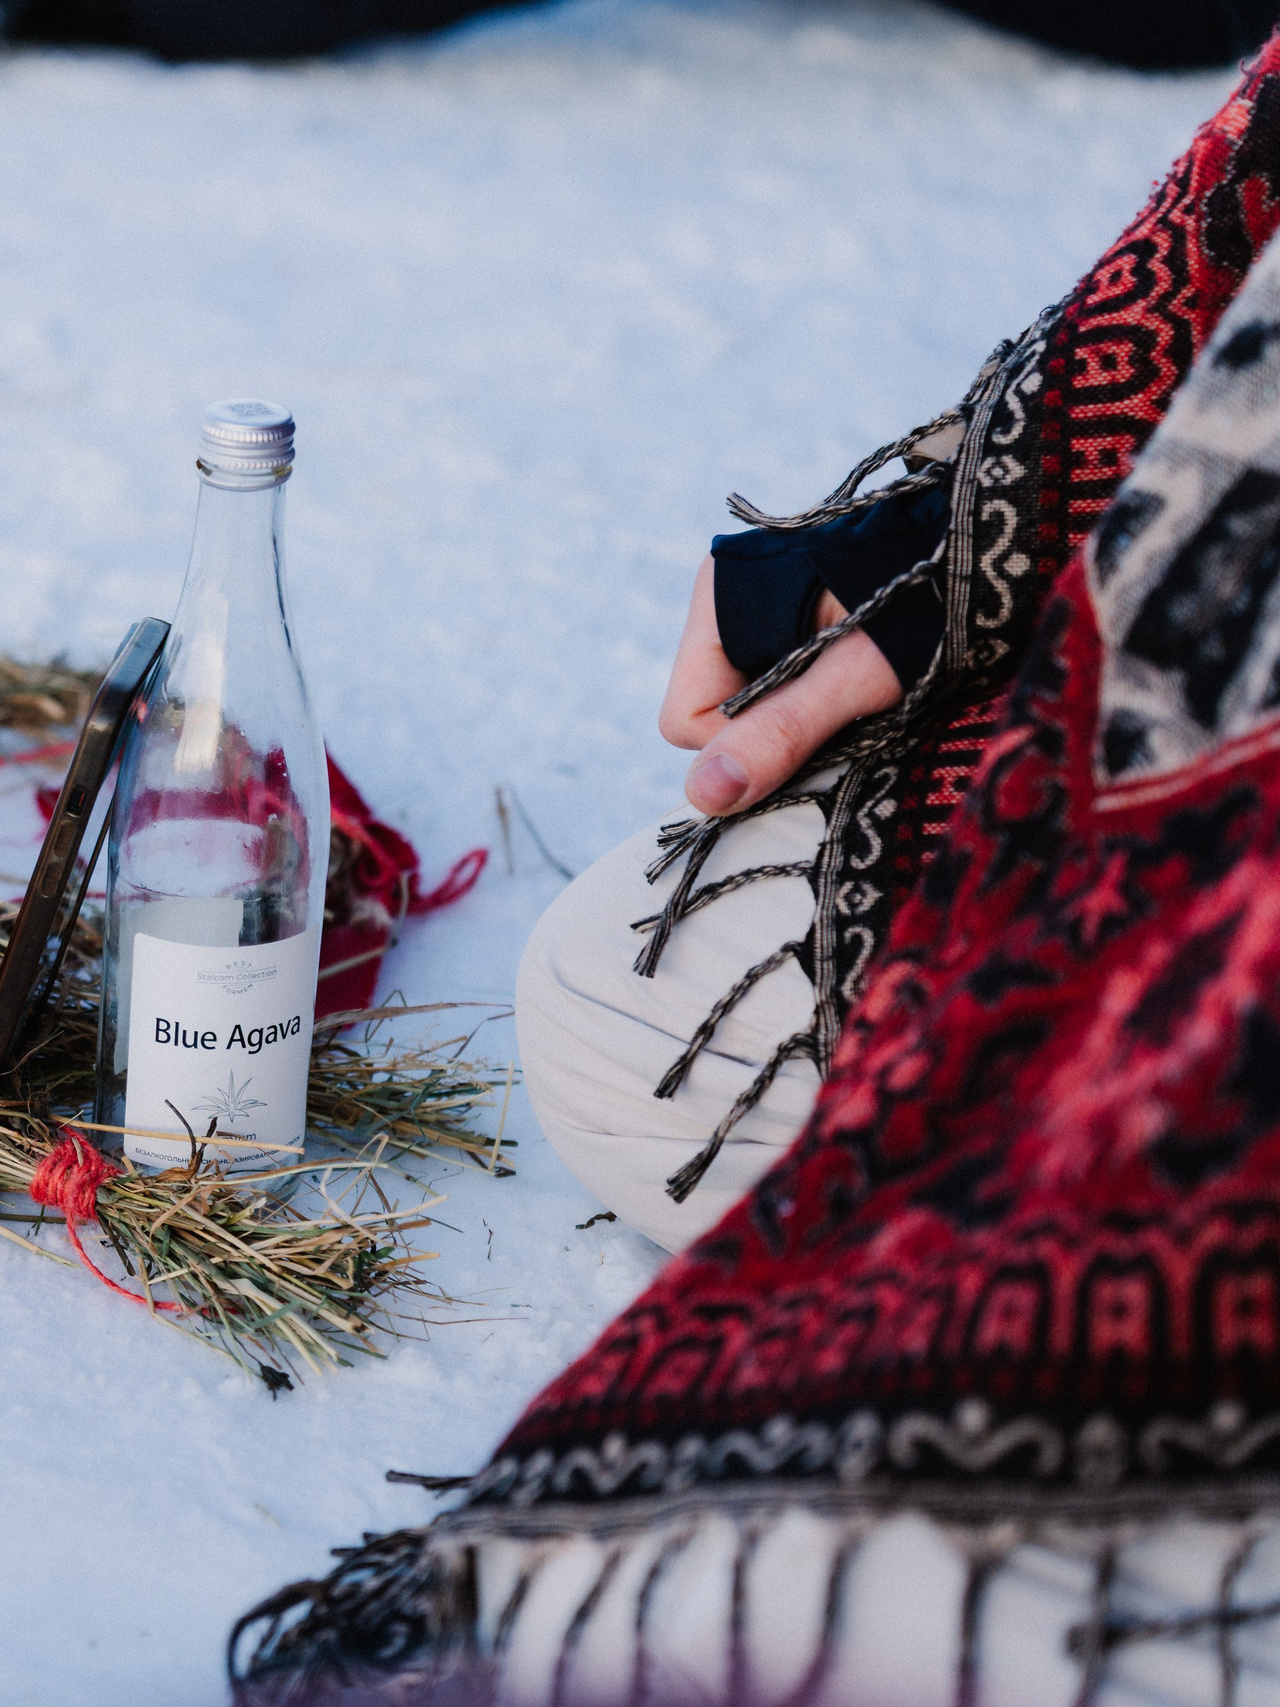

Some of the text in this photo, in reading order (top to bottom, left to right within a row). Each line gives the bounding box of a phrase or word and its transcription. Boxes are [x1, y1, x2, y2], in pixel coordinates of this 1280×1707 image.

[226, 961, 252, 970] BEST
[197, 969, 277, 982] Stalcom Collection
[154, 1015, 301, 1054] Blue Agava
[135, 1147, 191, 1165] БЕЗАЛКОГОЛЬН
